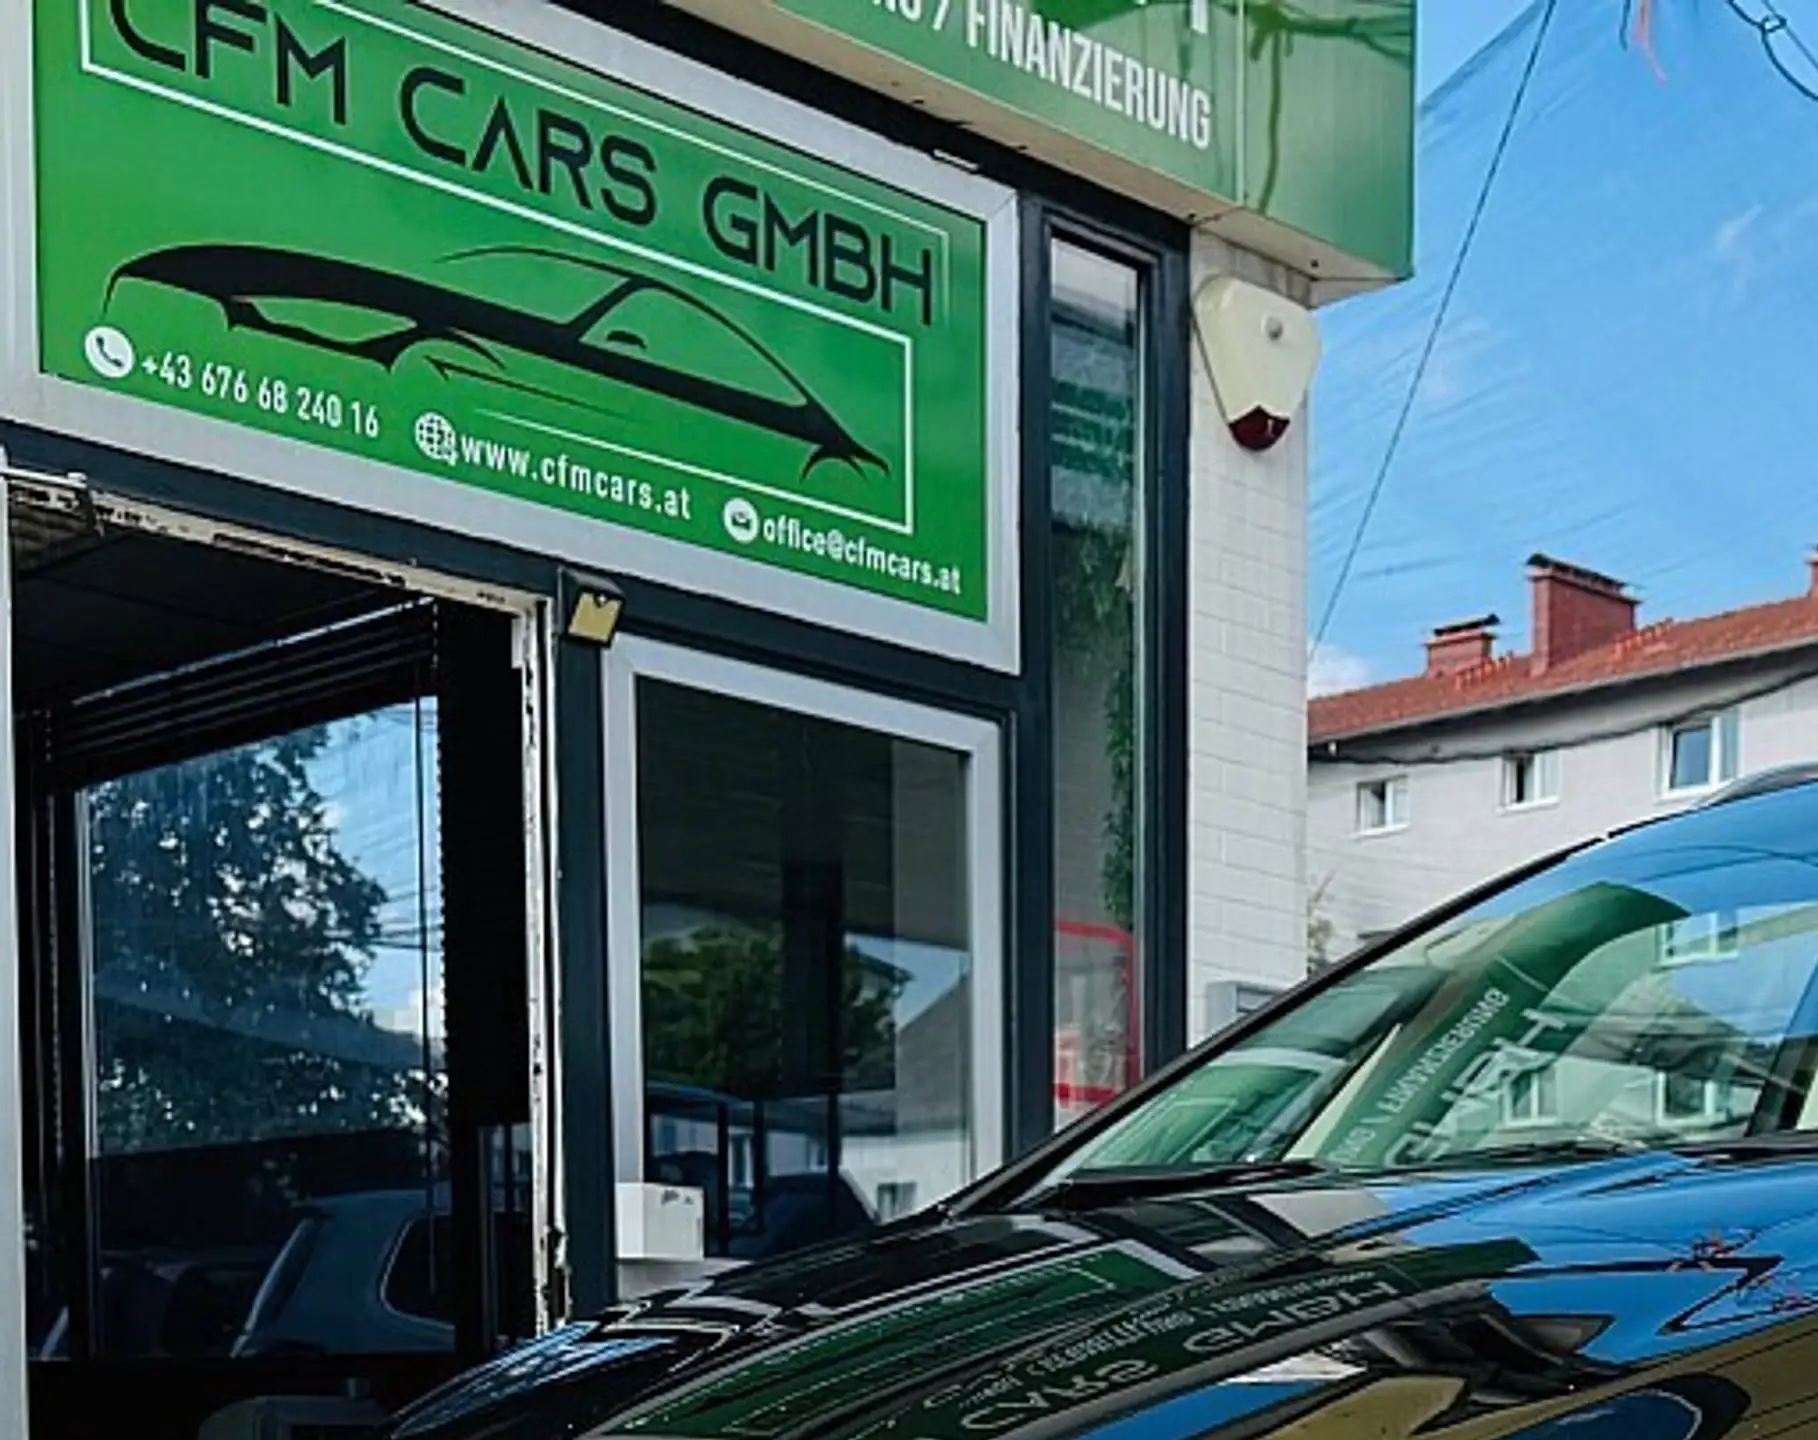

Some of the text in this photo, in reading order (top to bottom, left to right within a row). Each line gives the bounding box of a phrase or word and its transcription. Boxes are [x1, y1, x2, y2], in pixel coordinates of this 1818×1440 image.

[966, 0, 1211, 150] FINANZIERUNG
[110, 0, 932, 326] CFM CARS GMBH
[141, 350, 381, 438] +43 676 68 240 16
[461, 434, 691, 521] www.cfmcars.at
[763, 516, 962, 596] office@cfmcars.at
